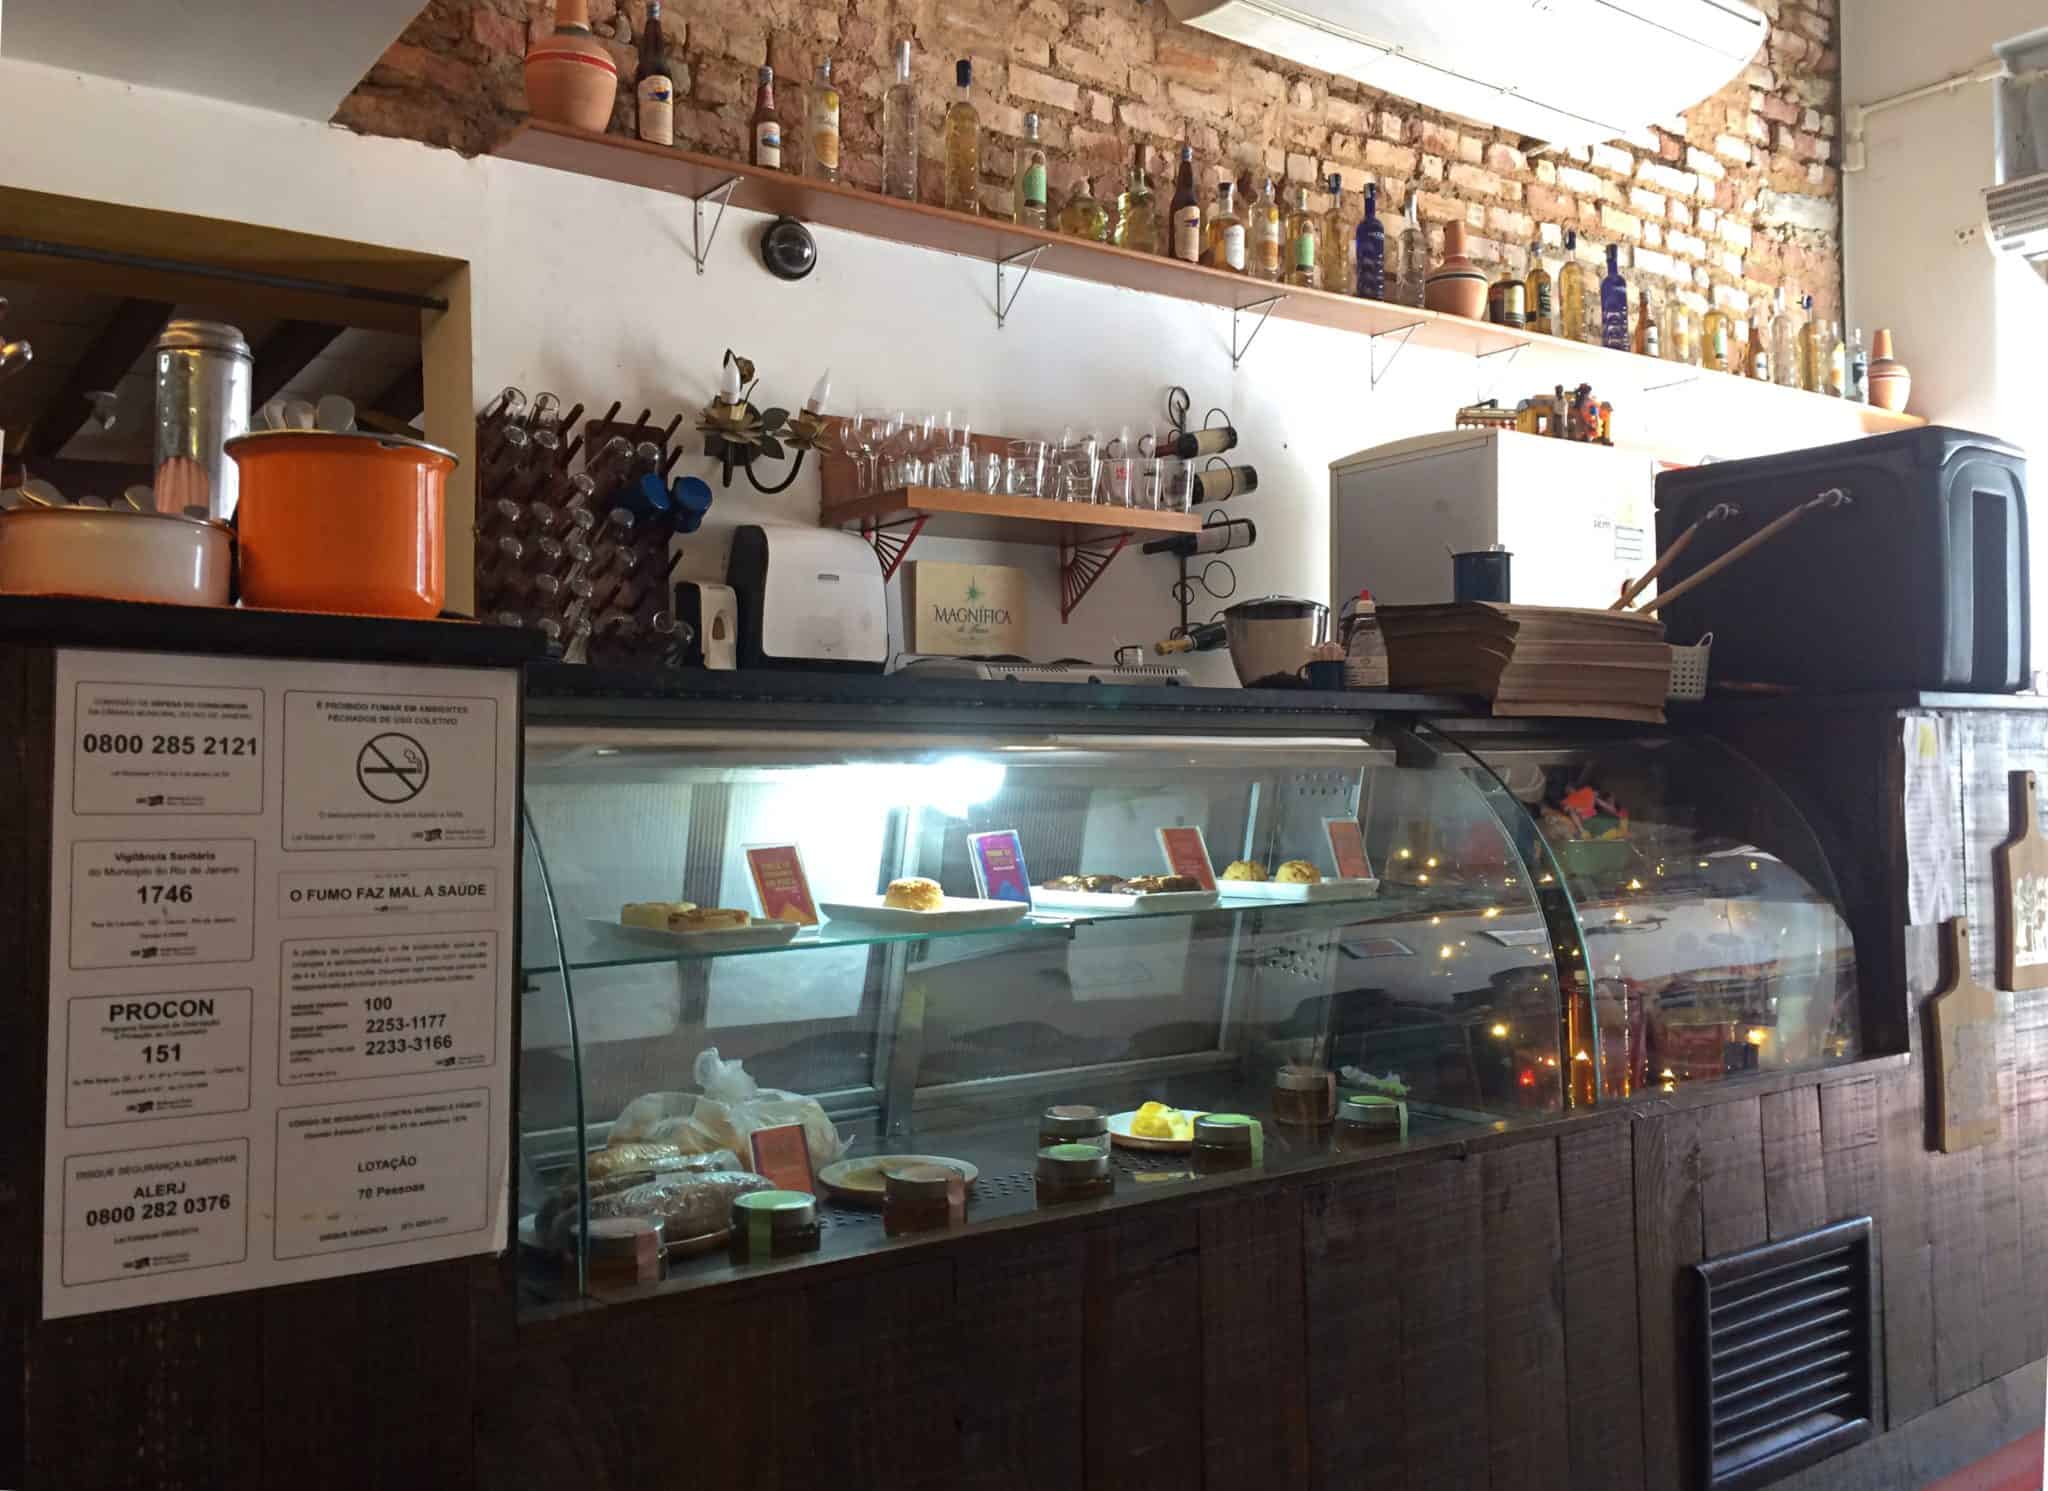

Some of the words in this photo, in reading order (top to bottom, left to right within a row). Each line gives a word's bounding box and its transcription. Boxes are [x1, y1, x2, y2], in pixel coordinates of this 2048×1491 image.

[371, 703, 402, 711] FUMAR
[327, 714, 377, 723] FECHADOS
[414, 716, 458, 726] COLETIVO
[83, 733, 144, 754] 0800
[152, 735, 196, 755] 285
[203, 737, 257, 757] 2121
[137, 884, 193, 904] 1746
[290, 889, 302, 903] O
[307, 887, 352, 902] FUMO
[357, 887, 385, 900] FAZ
[389, 886, 421, 898] MAL
[109, 999, 215, 1022] PROCON
[364, 996, 392, 1010] 100
[365, 1014, 447, 1033] 2253-1177
[142, 1043, 181, 1064] 151
[365, 1034, 453, 1056] 2233-3166
[357, 1155, 417, 1173] LOTAÇÃO
[133, 1182, 186, 1199] ALERJ
[358, 1187, 373, 1200] 70
[376, 1183, 425, 1198] Pessoas
[86, 1206, 136, 1227] 0800
[141, 1200, 178, 1220] 282
[183, 1193, 231, 1214] 0376
